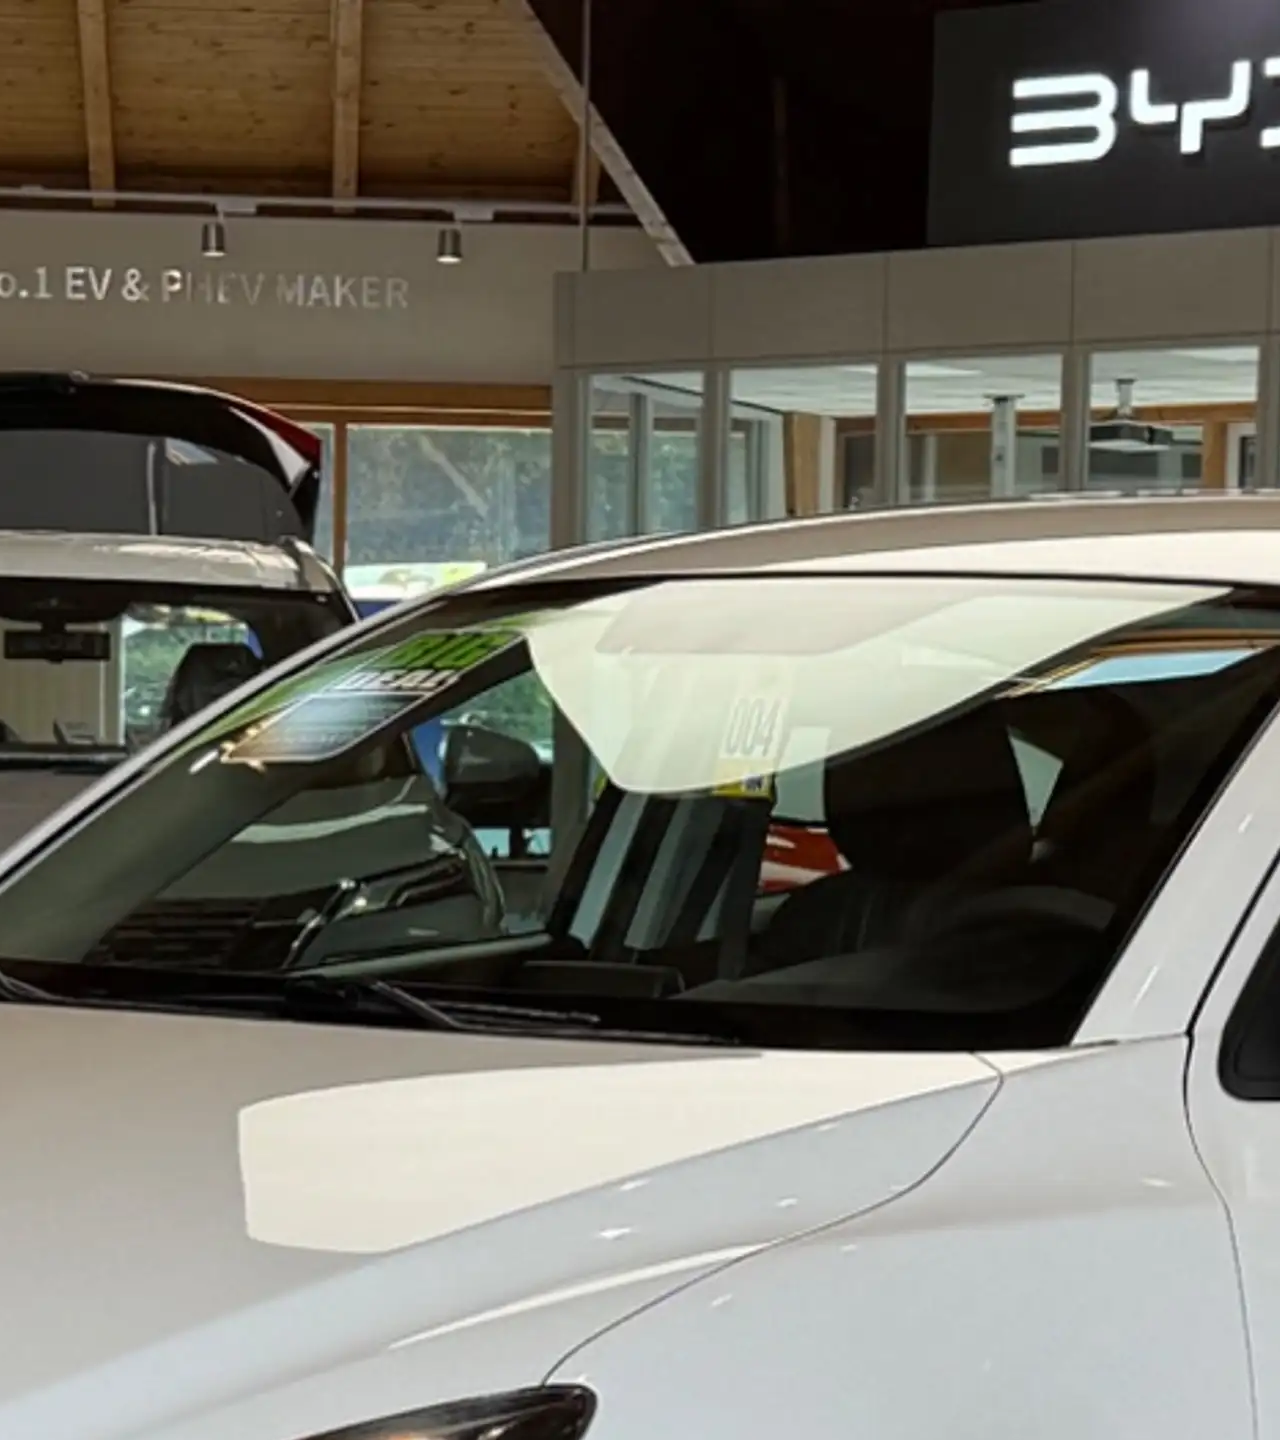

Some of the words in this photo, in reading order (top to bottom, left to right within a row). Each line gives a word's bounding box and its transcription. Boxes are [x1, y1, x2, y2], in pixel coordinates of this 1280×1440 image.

[65, 266, 112, 301] EV
[121, 267, 150, 302] &
[276, 273, 410, 309] MAKER
